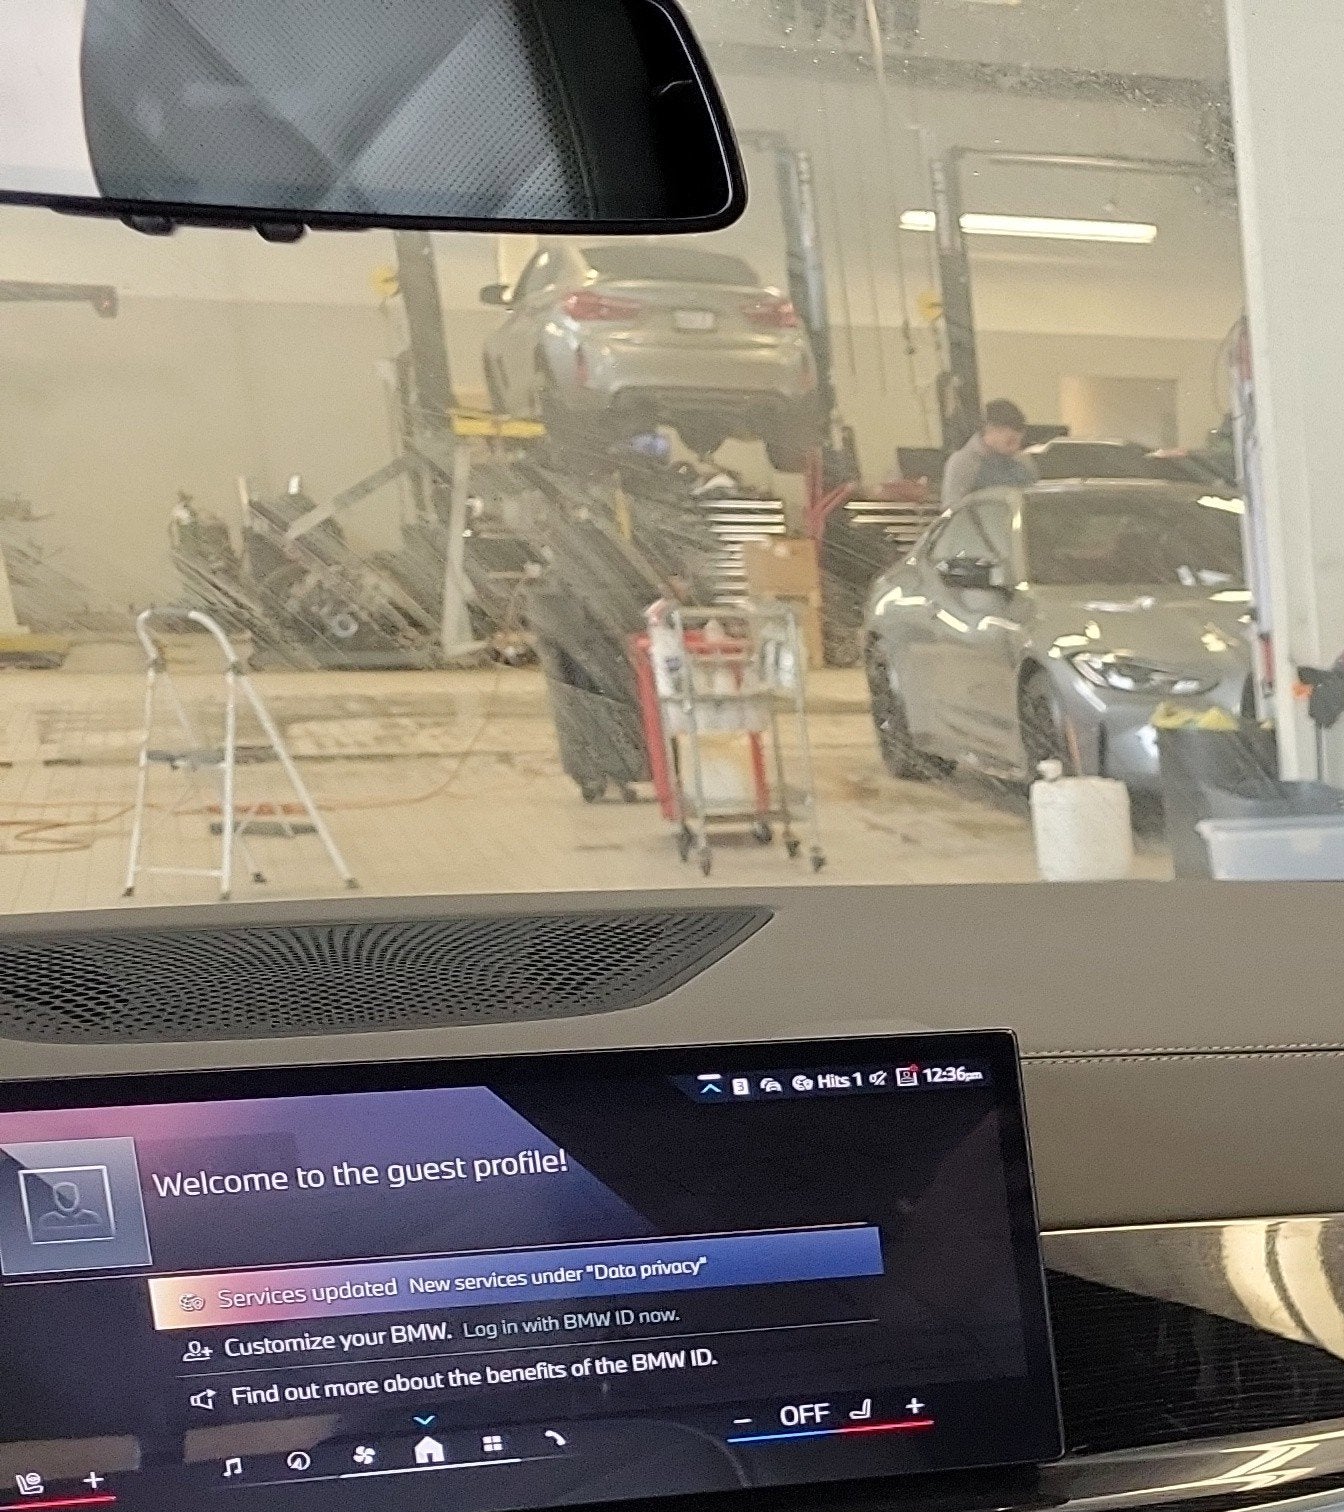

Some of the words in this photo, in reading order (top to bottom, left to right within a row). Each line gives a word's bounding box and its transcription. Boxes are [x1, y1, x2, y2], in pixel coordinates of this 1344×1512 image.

[817, 1074, 851, 1089] Hits
[853, 1071, 863, 1087] 1
[152, 1171, 288, 1197] Welcome
[296, 1167, 325, 1188] to
[332, 1162, 379, 1186] the
[387, 1158, 467, 1188] guest
[474, 1148, 568, 1182] profile!
[218, 1287, 307, 1308] Services
[312, 1278, 398, 1303] updated
[409, 1278, 450, 1294] New
[455, 1272, 527, 1291] services
[532, 1267, 583, 1285] under
[586, 1264, 637, 1280] "Data
[640, 1256, 707, 1280] privacy"
[225, 1332, 336, 1357] Customize
[339, 1331, 387, 1351] your
[390, 1322, 453, 1344] BMW.
[463, 1322, 498, 1339] Log
[502, 1319, 518, 1334] in
[522, 1315, 560, 1333] with
[564, 1311, 611, 1330] BMW
[615, 1309, 635, 1326] ID
[639, 1309, 681, 1324] now.
[231, 1384, 279, 1405] Find
[284, 1383, 320, 1402] out
[324, 1380, 379, 1397] more
[384, 1373, 444, 1393] about
[449, 1368, 482, 1387] the
[486, 1362, 567, 1384] benefits
[571, 1358, 592, 1376] of
[594, 1356, 628, 1375] the
[631, 1350, 686, 1372] BMW
[690, 1348, 718, 1367] ID.
[779, 1402, 831, 1426] OFF
